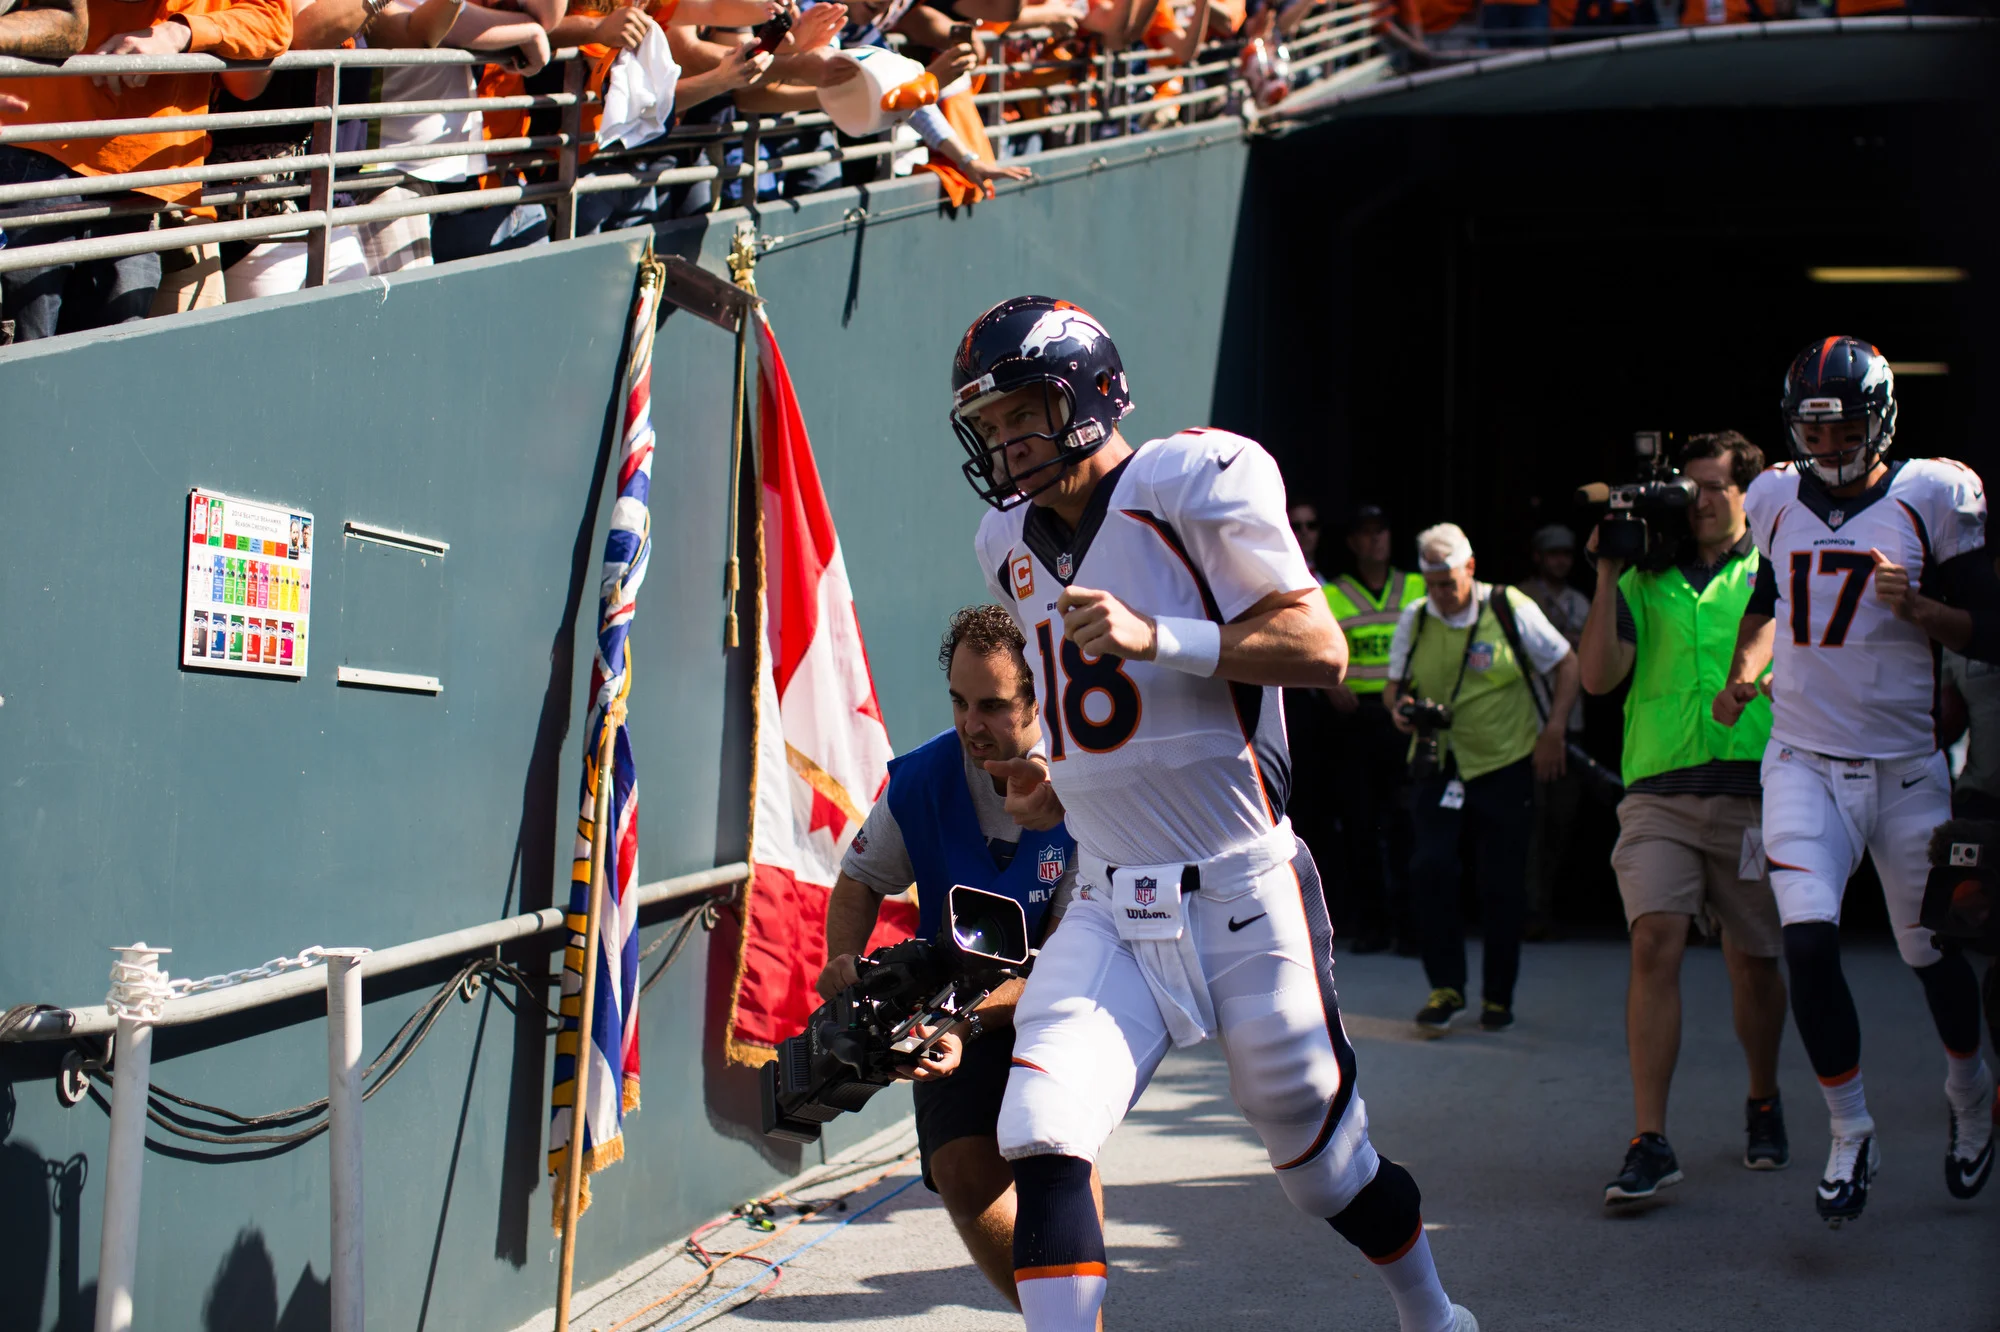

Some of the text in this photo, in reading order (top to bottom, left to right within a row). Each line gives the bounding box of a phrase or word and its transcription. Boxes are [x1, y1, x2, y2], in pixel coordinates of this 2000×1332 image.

[1013, 558, 1031, 588] C
[1790, 550, 1878, 648] 17
[1035, 618, 1142, 762] 18
[1040, 861, 1062, 880] NFL
[1029, 890, 1048, 903] NFL
[1136, 888, 1155, 903] NFL
